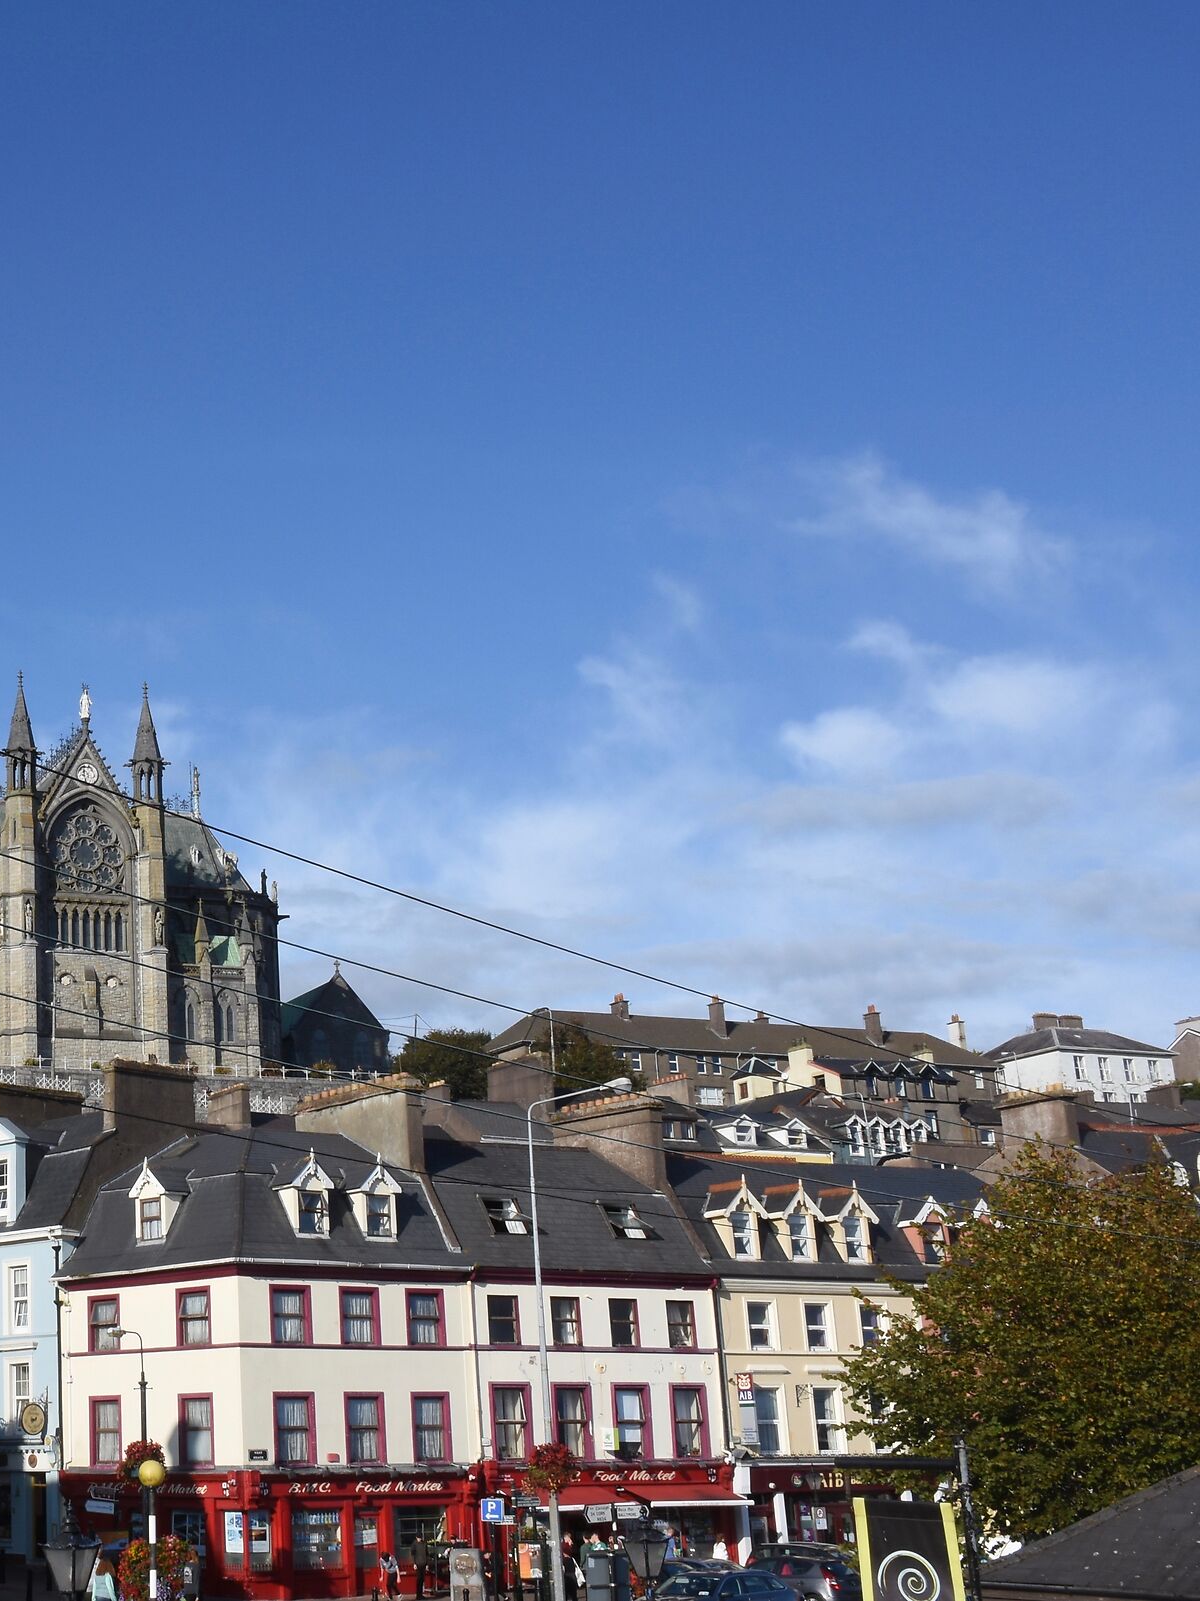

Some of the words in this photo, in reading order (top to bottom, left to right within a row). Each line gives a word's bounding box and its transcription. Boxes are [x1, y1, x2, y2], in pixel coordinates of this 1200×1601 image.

[739, 1391, 753, 1400] AIB
[593, 1470, 627, 1482] Food
[629, 1470, 676, 1481] Market
[168, 1483, 208, 1495] Market
[288, 1482, 331, 1493] B.M.C.
[355, 1481, 391, 1493] Food
[395, 1481, 443, 1492] Market
[488, 1502, 496, 1512] P
